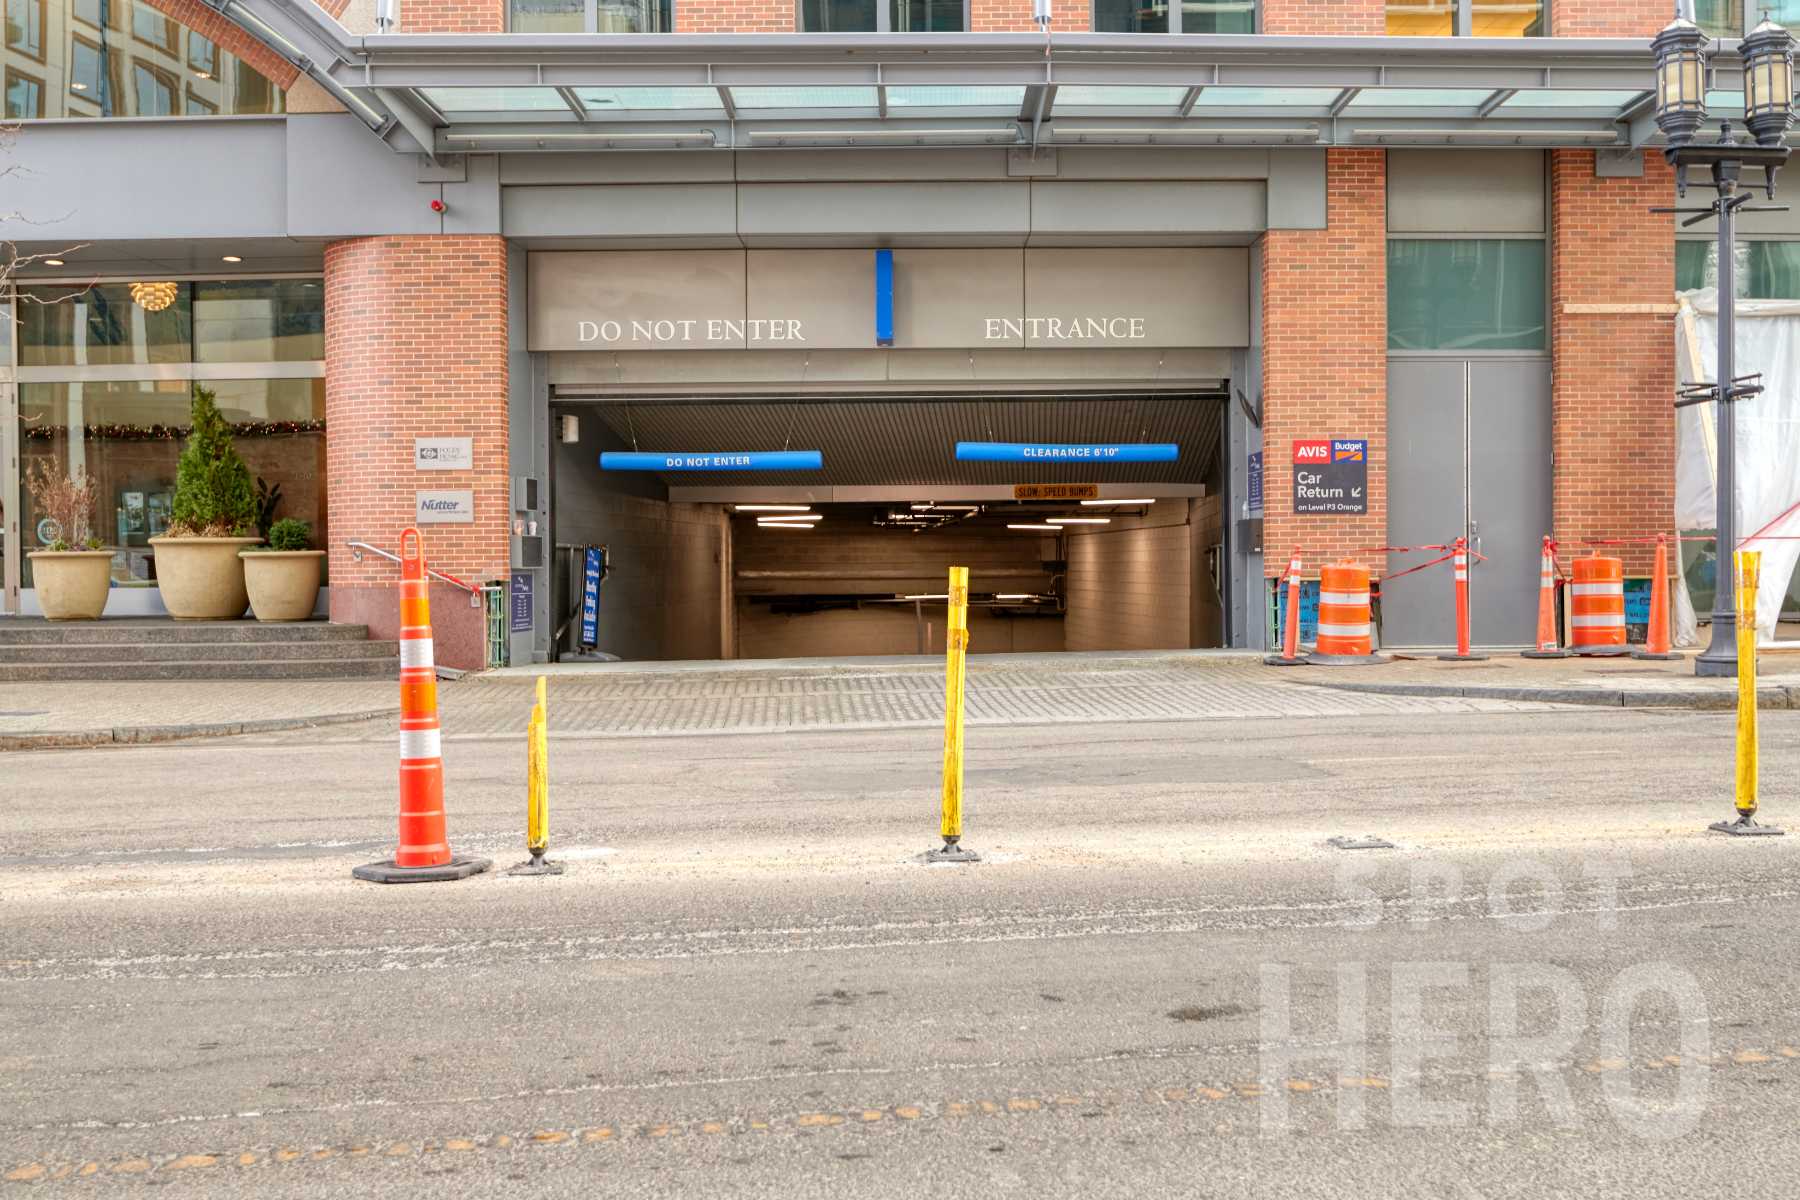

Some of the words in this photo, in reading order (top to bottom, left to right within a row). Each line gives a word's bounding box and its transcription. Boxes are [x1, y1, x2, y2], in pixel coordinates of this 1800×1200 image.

[578, 320, 622, 342] DO
[632, 320, 697, 341] NOT
[706, 319, 806, 341] ENTER
[984, 317, 1146, 340] ENTRANCE
[1023, 447, 1090, 457] CLEARANCE
[1297, 446, 1328, 458] AVIS
[1335, 442, 1363, 452] Budget
[666, 457, 683, 467] DO
[687, 457, 710, 467] NOT
[714, 456, 751, 466] ENTER
[1297, 471, 1322, 484] Car
[1044, 486, 1067, 497] SPEED
[1069, 486, 1094, 497] BUMPS
[1297, 485, 1344, 498] Return
[421, 499, 459, 511] Nutter
[1308, 503, 1326, 511] Level
[1327, 503, 1336, 511] P3
[1337, 503, 1363, 512] Orange
